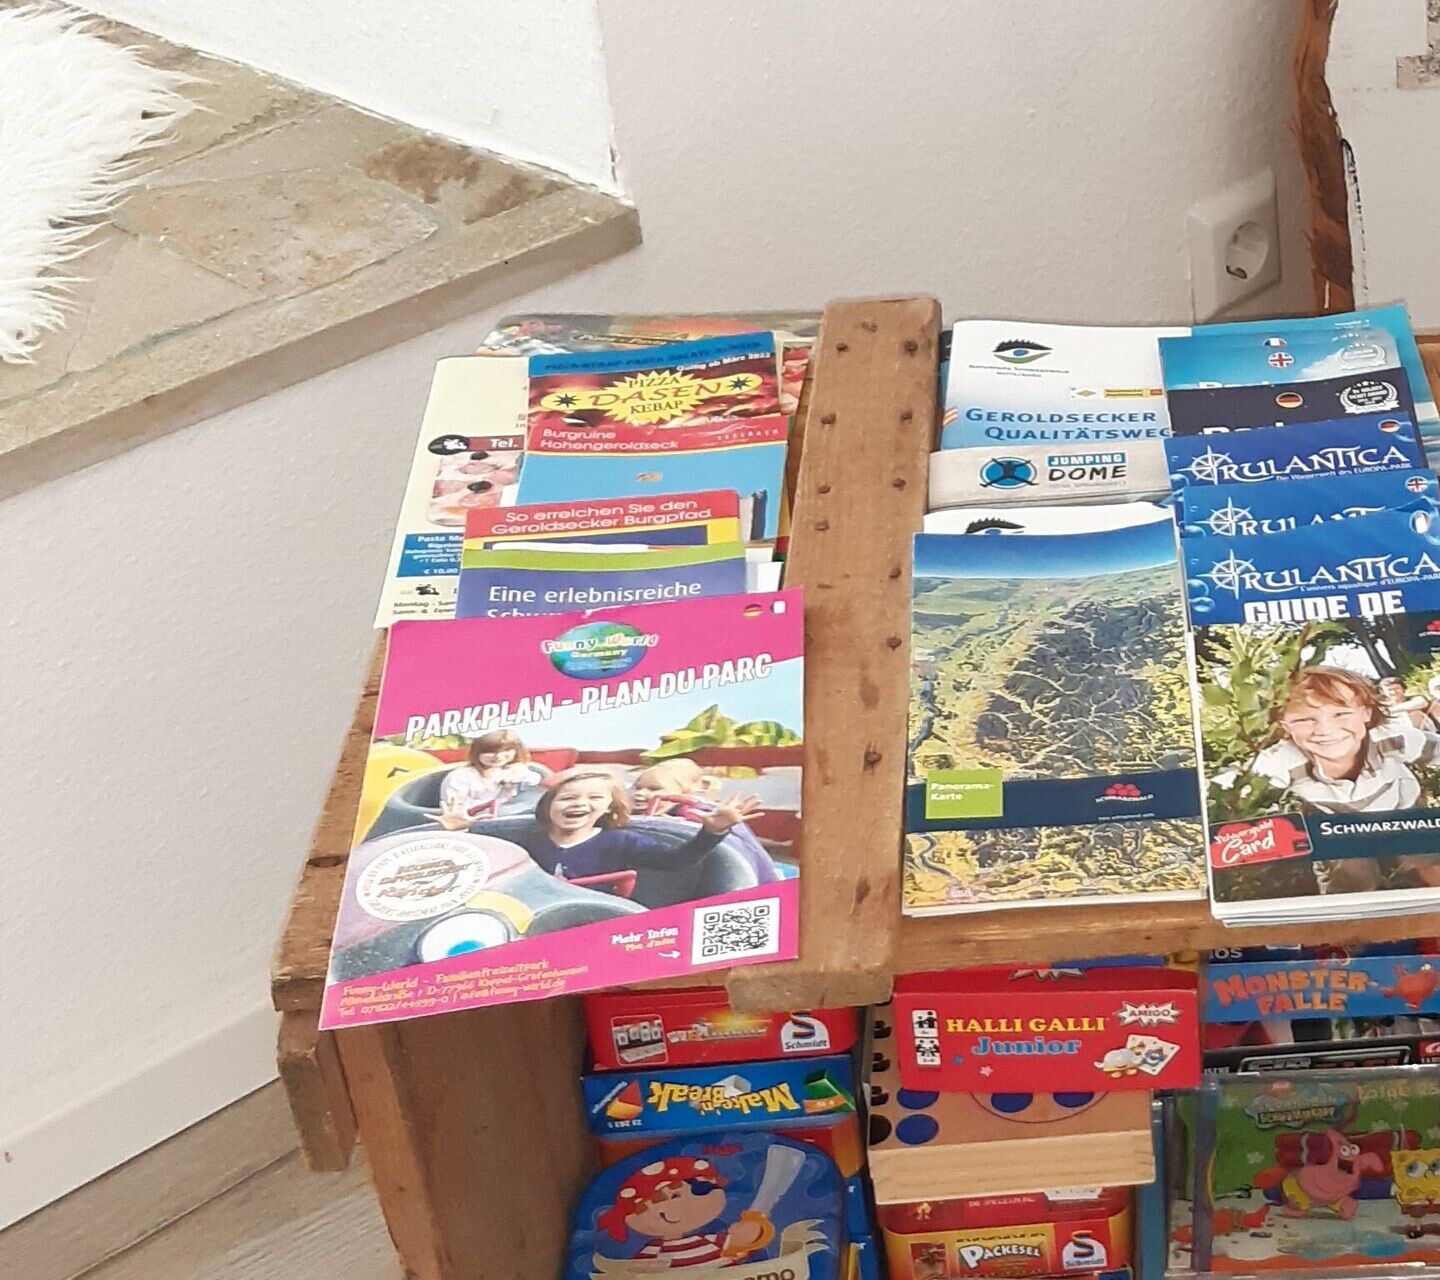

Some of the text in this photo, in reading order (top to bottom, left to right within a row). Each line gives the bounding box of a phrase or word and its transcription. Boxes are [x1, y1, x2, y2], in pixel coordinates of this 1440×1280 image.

[627, 375, 681, 388] PIZZA
[588, 382, 722, 407] DASEN
[630, 399, 684, 415] KEBAP
[965, 408, 1156, 423] GEROLDSECKER
[543, 428, 617, 441] Burgruine
[984, 426, 1173, 440] QUALITÄTSWEG
[490, 438, 518, 449] Tel.
[540, 440, 679, 451] Hohengeroldseck
[1049, 455, 1123, 466] JUMPING
[1215, 445, 1411, 483] RULANTICA
[1048, 465, 1127, 481] DOME
[505, 498, 698, 523] So erreichen Sie den
[491, 508, 712, 534] Geroldsecker Burgpfad
[489, 581, 702, 603] Eine erlebnisreiche
[1243, 594, 1350, 623] GUIDE
[404, 653, 774, 742] PARKPLAN PLAN DU PARC
[930, 792, 963, 801] Karte
[1221, 833, 1276, 864] Card
[612, 932, 644, 945] Mehr
[1214, 968, 1379, 1008] MONSTER-
[1257, 991, 1348, 1015] FALLE
[1128, 1008, 1171, 1018] AMIGO
[945, 1017, 1106, 1033] HALLI GALLI
[784, 1039, 828, 1050] Schmidt
[971, 1035, 1083, 1056] Junior
[646, 1081, 801, 1115] Make Break
[959, 1243, 1041, 1269] PACKESEL
